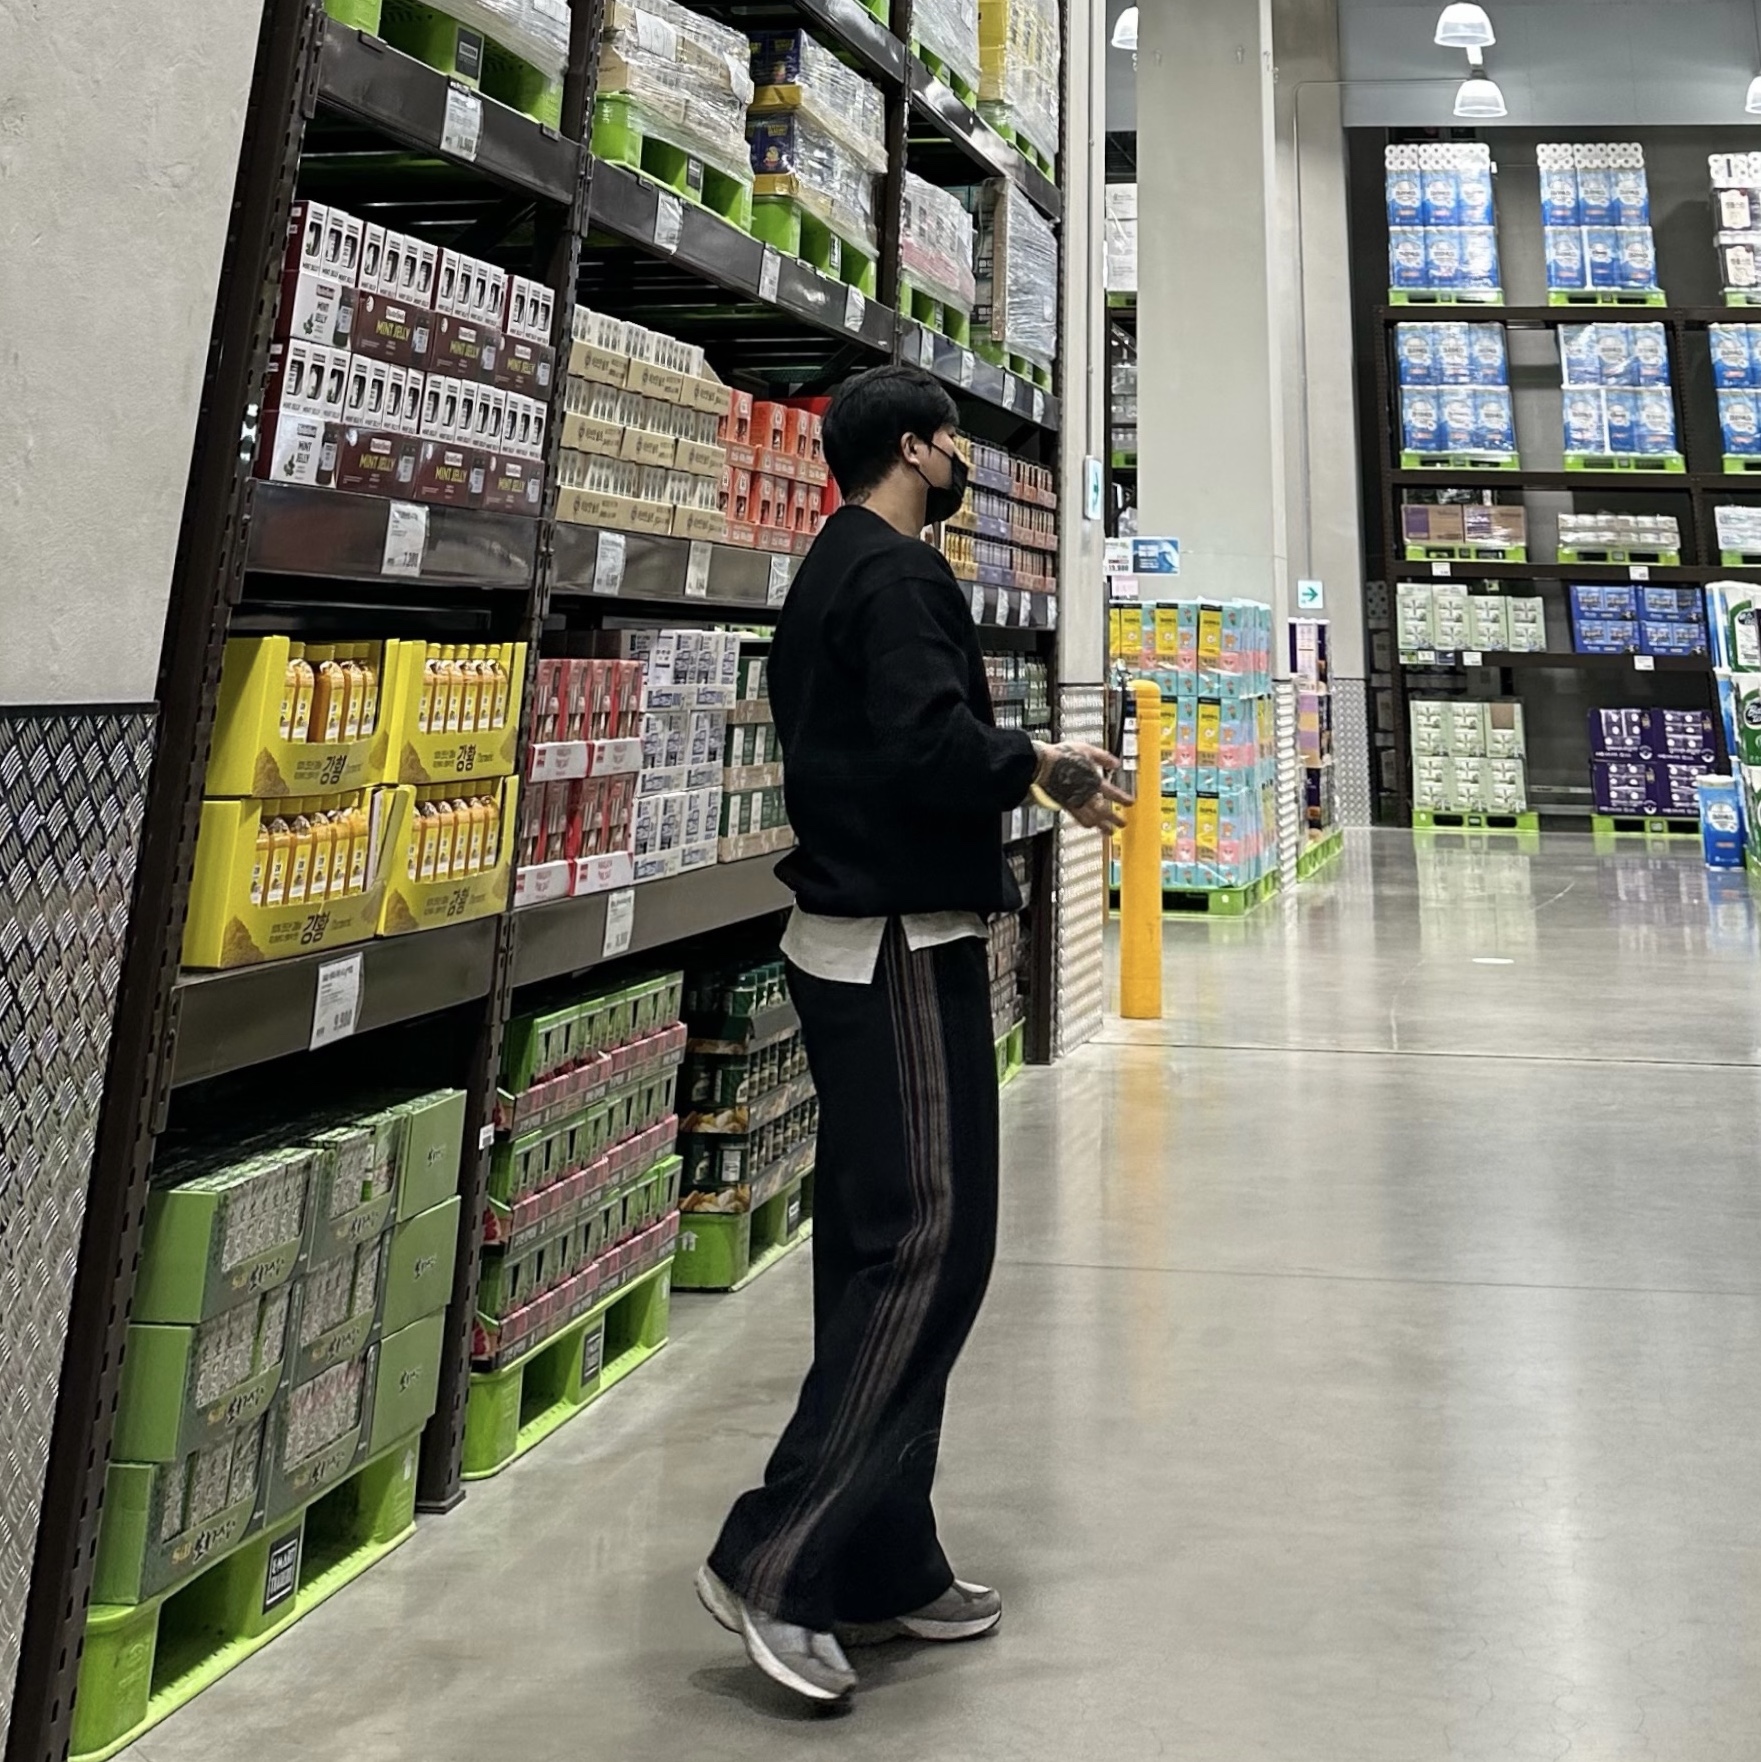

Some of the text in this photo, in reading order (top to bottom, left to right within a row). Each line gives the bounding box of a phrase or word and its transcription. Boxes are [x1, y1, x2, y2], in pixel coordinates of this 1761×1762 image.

[358, 453, 378, 469] MINT
[320, 755, 347, 785] 강황
[456, 744, 476, 772] 강황
[301, 911, 331, 945] 강황
